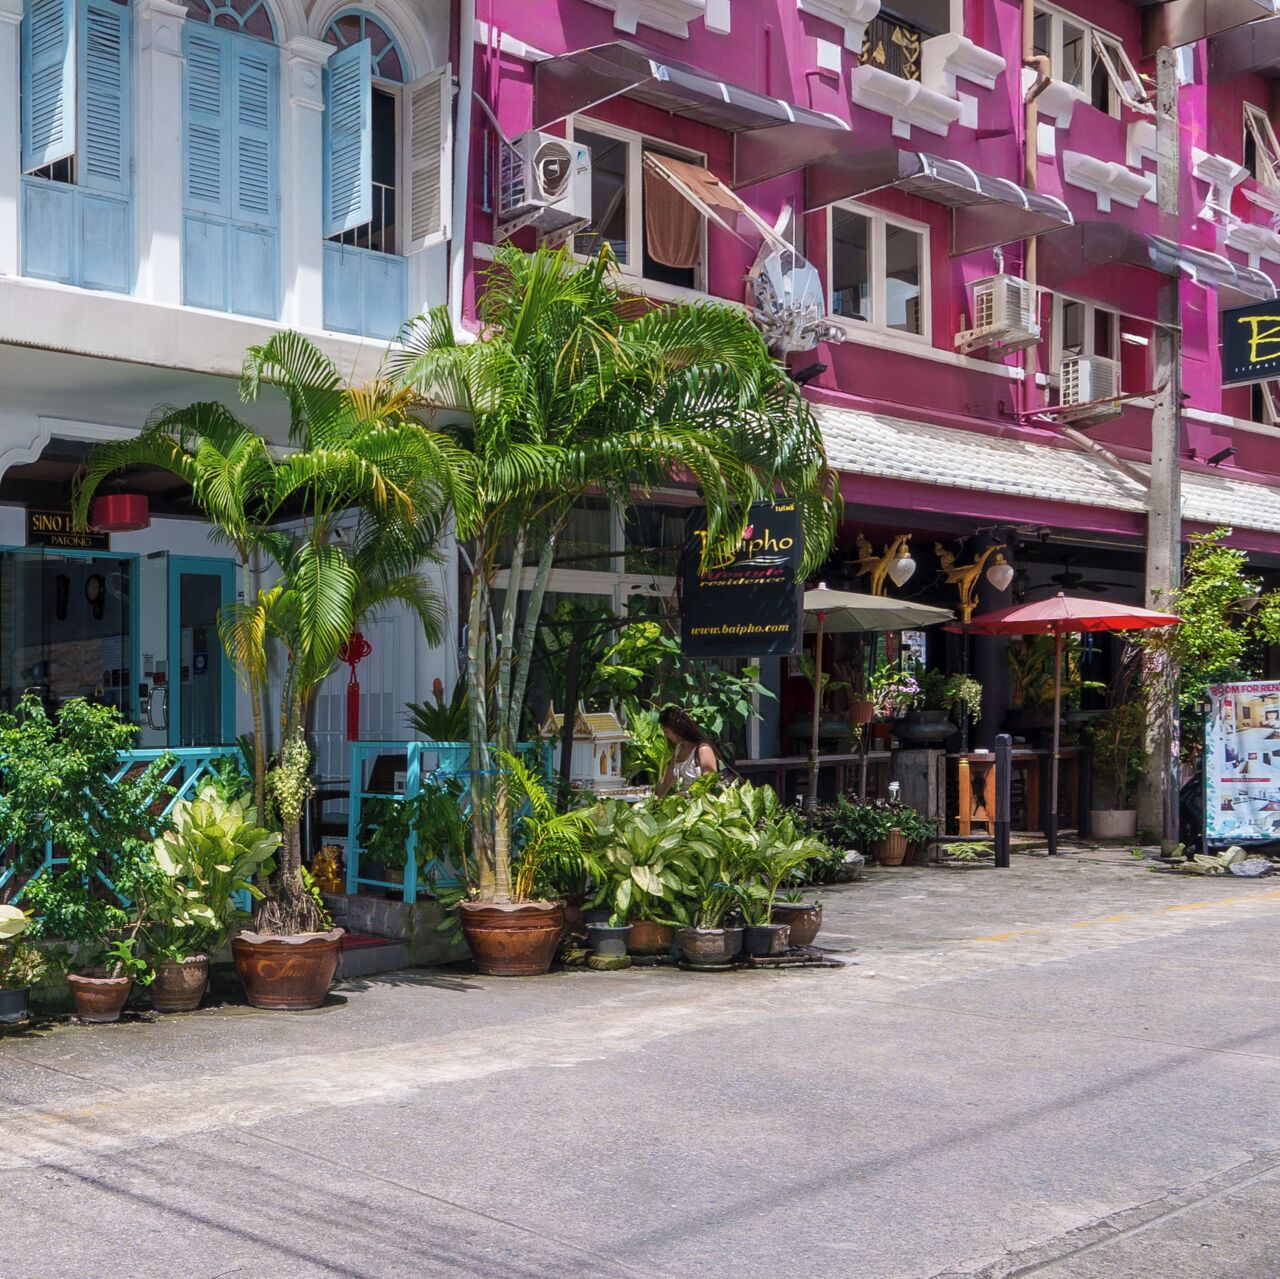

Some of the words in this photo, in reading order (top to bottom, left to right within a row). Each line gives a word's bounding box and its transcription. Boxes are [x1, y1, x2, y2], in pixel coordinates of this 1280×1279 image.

[32, 515, 62, 531] SINO
[51, 535, 92, 547] PATONG
[694, 528, 794, 570] Bipho
[700, 577, 786, 587] residence
[690, 624, 790, 636] www.baipho.com
[1209, 685, 1240, 696] ROOM
[1241, 684, 1260, 693] FOR
